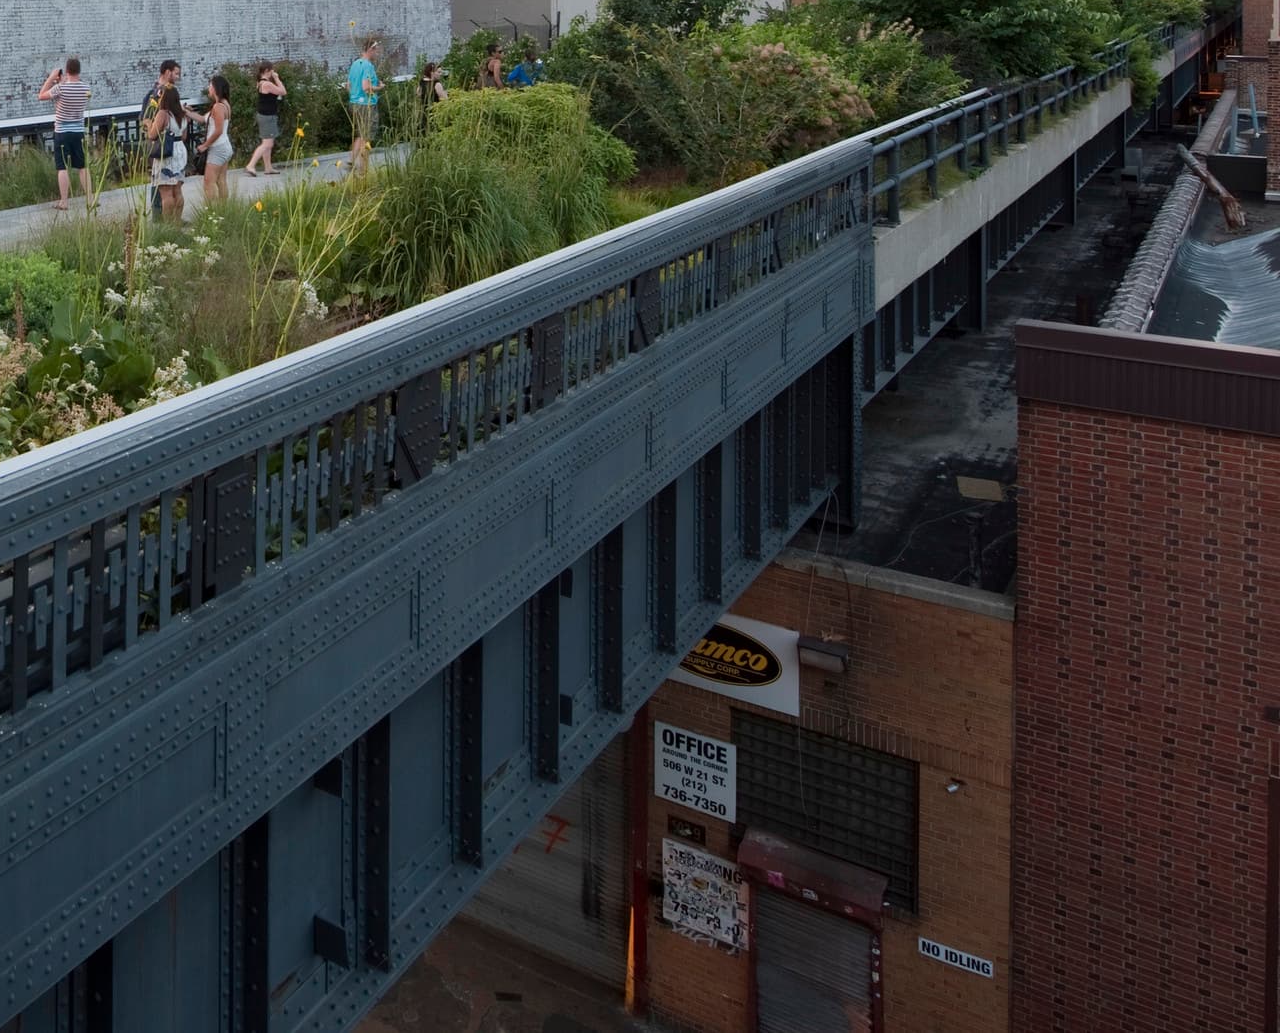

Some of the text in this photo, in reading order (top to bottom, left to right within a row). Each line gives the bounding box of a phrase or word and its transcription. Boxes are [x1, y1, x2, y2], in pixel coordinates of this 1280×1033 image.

[687, 656, 741, 676] SUPPLY CORP.
[662, 729, 727, 764] OFFICE
[662, 747, 728, 774] AROUND THE CORNER
[663, 758, 727, 788] 506 W 21 ST.
[681, 777, 707, 794] (212)
[662, 784, 726, 816] 736-7350
[921, 940, 991, 975] NO IDLING
